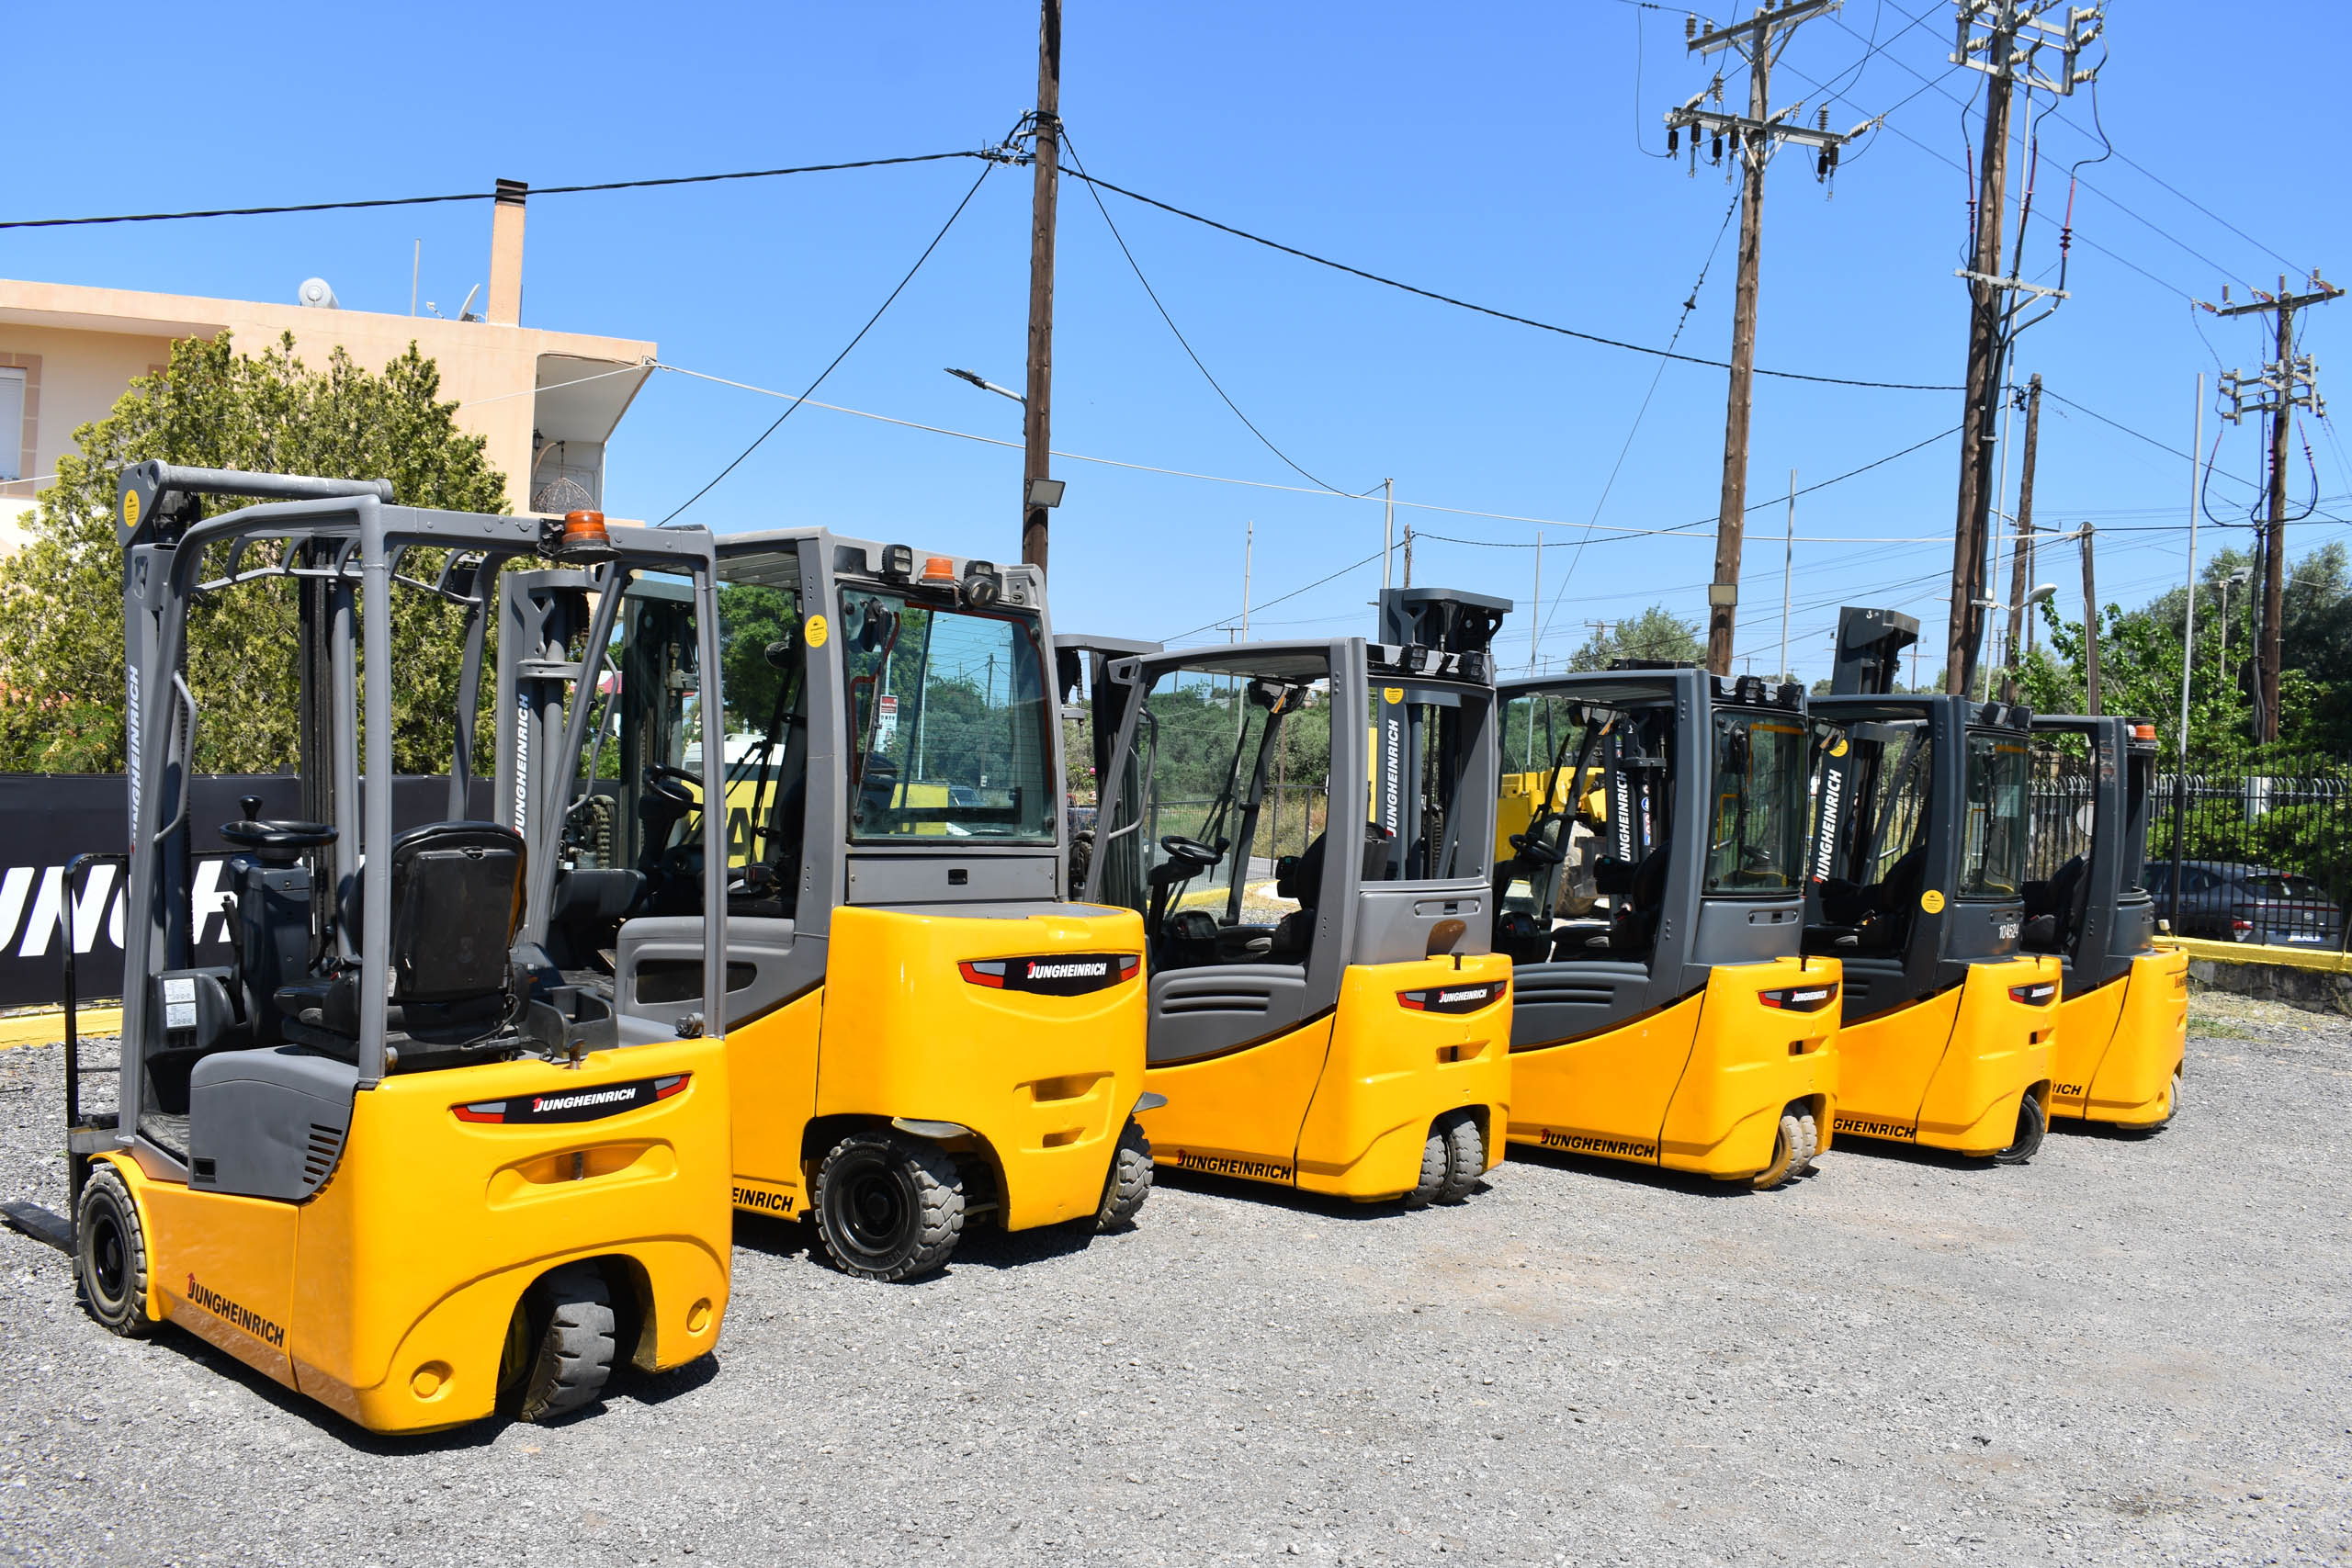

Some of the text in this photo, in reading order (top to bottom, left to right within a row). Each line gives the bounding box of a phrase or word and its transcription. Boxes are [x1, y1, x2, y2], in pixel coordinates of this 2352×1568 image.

[130, 664, 141, 845] NGHEINRICH
[515, 694, 529, 840] JUNGHEINRICH
[1386, 718, 1399, 838] JUNGHEINRICH
[1616, 770, 1632, 863] UNGHEINRICH
[1815, 768, 1843, 882] JUNGHEINRICH
[1026, 962, 1107, 979] JUNGHEINRICH
[532, 1088, 637, 1112] JUNGHEINRICH
[1540, 1132, 1656, 1158] JUNGHEINRICH
[1833, 1118, 1917, 1139] GHEINRICH
[1176, 1153, 1293, 1180] JUNGHEINRICH
[732, 1187, 795, 1213] EINRICH
[187, 1280, 285, 1348] JUNGHEINRICH
